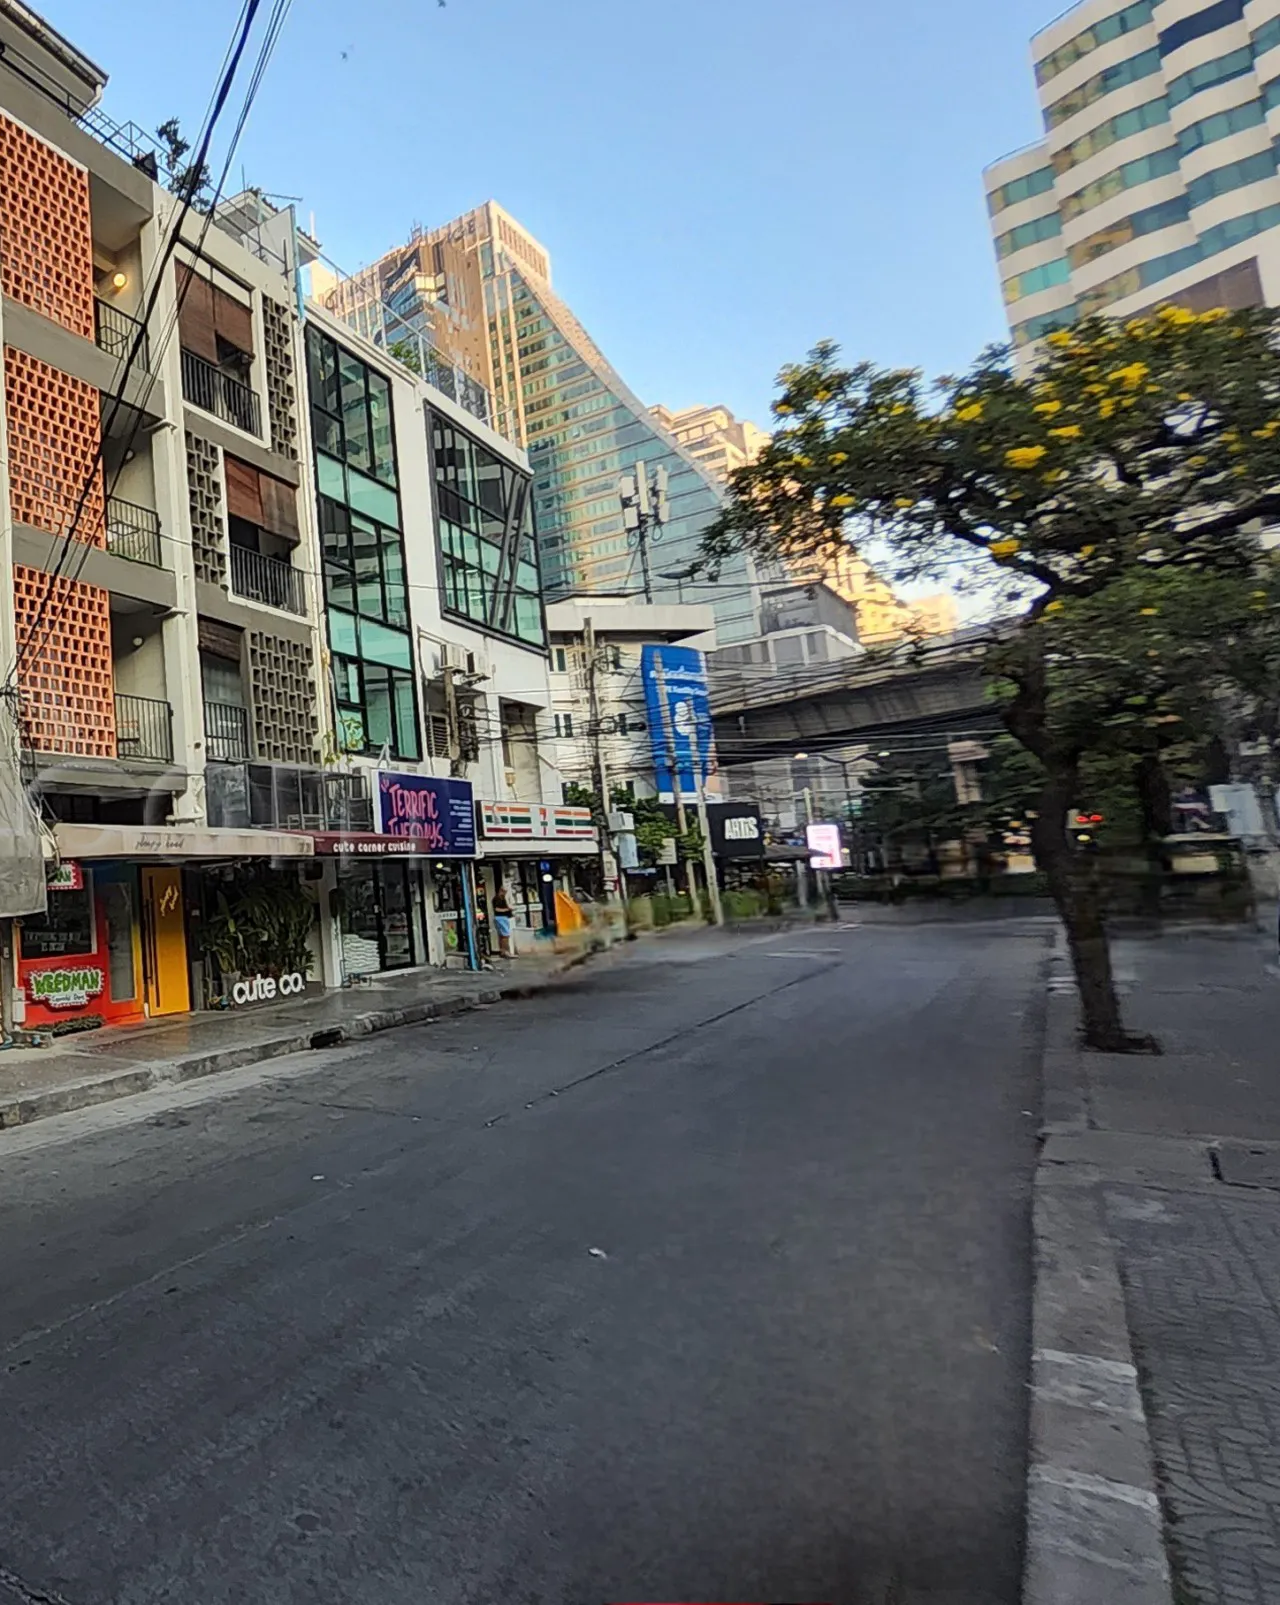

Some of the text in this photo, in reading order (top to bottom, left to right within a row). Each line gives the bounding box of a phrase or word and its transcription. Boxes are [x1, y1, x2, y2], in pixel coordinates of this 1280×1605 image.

[388, 784, 439, 820] TERRIFIC
[333, 840, 416, 853] cute corner cuisine
[33, 971, 100, 995] WEEDMAN
[232, 972, 306, 1005] cute co.
